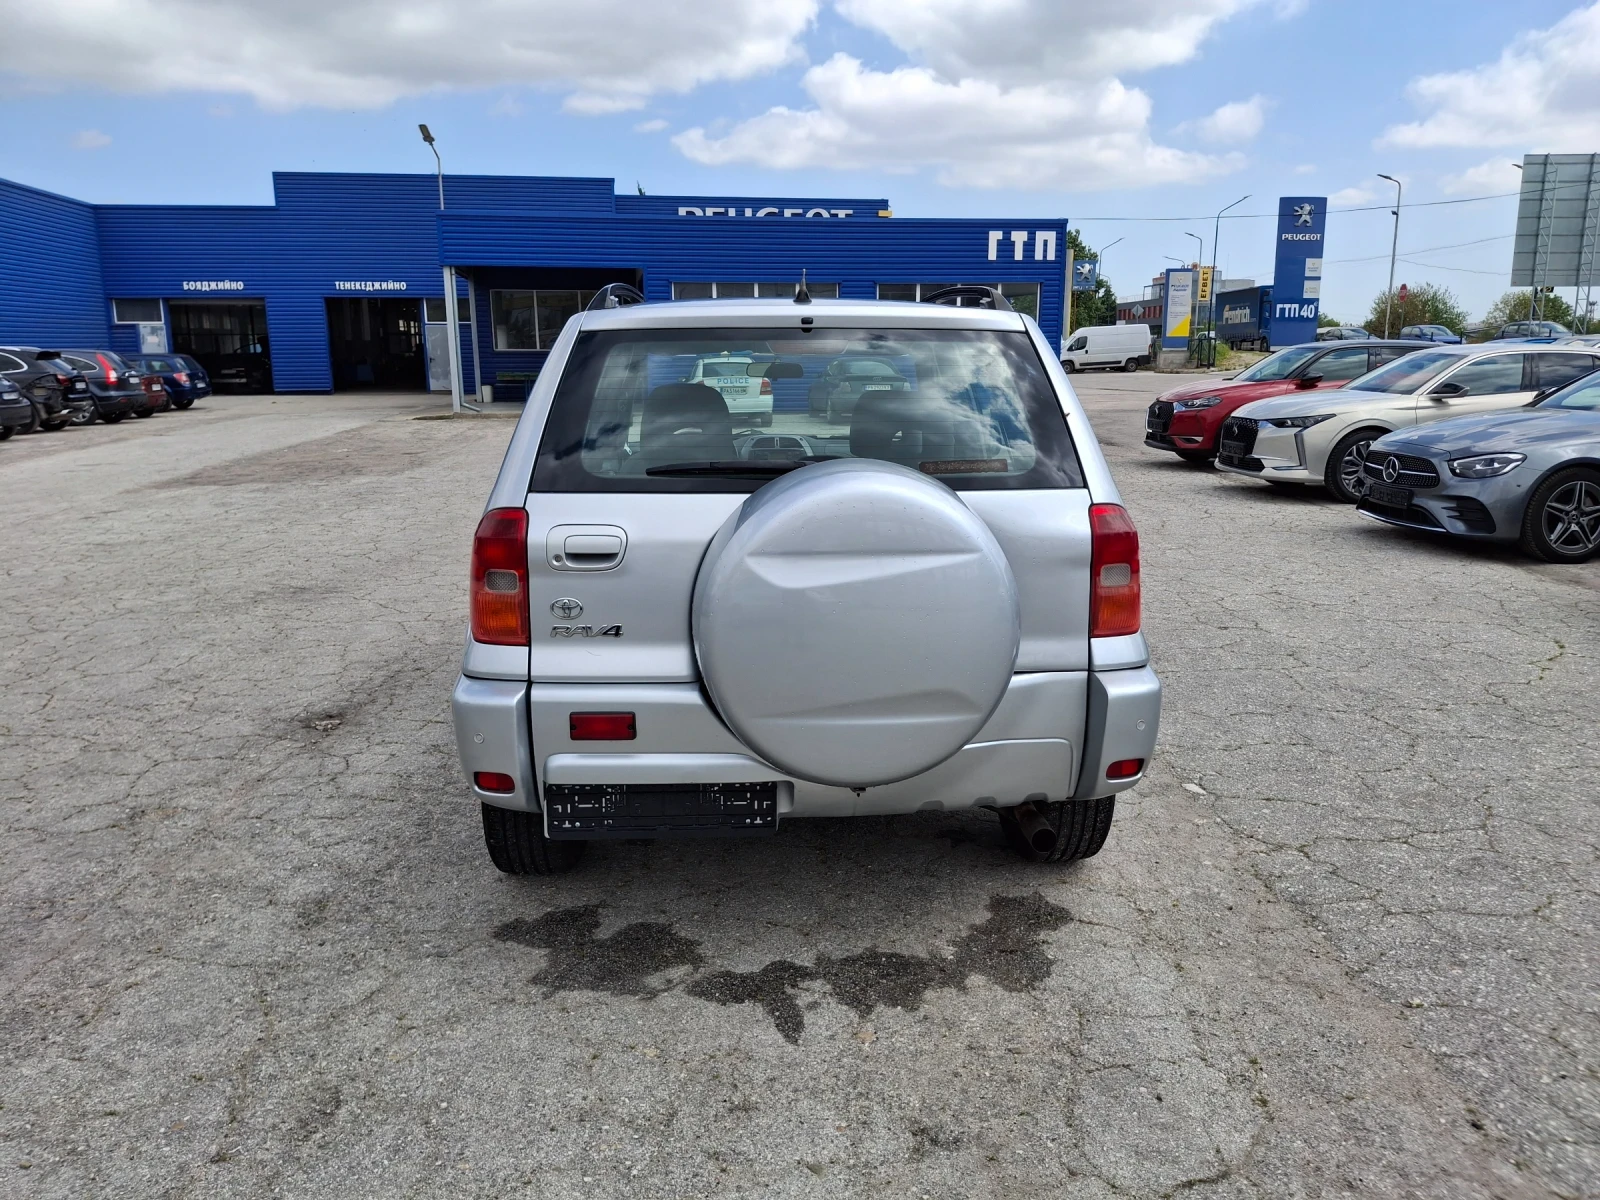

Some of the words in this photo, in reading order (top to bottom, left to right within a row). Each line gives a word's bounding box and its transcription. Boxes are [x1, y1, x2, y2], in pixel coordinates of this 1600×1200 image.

[987, 230, 1056, 261] ГТП
[182, 279, 244, 292] БОЯДЖИЙНО
[335, 280, 407, 292] ТЕНЕКЕДЖИЙНО
[1200, 270, 1209, 299] EFBET
[1275, 303, 1299, 318] ГТП
[716, 377, 750, 385] POLICE
[550, 624, 623, 638] RAV4
